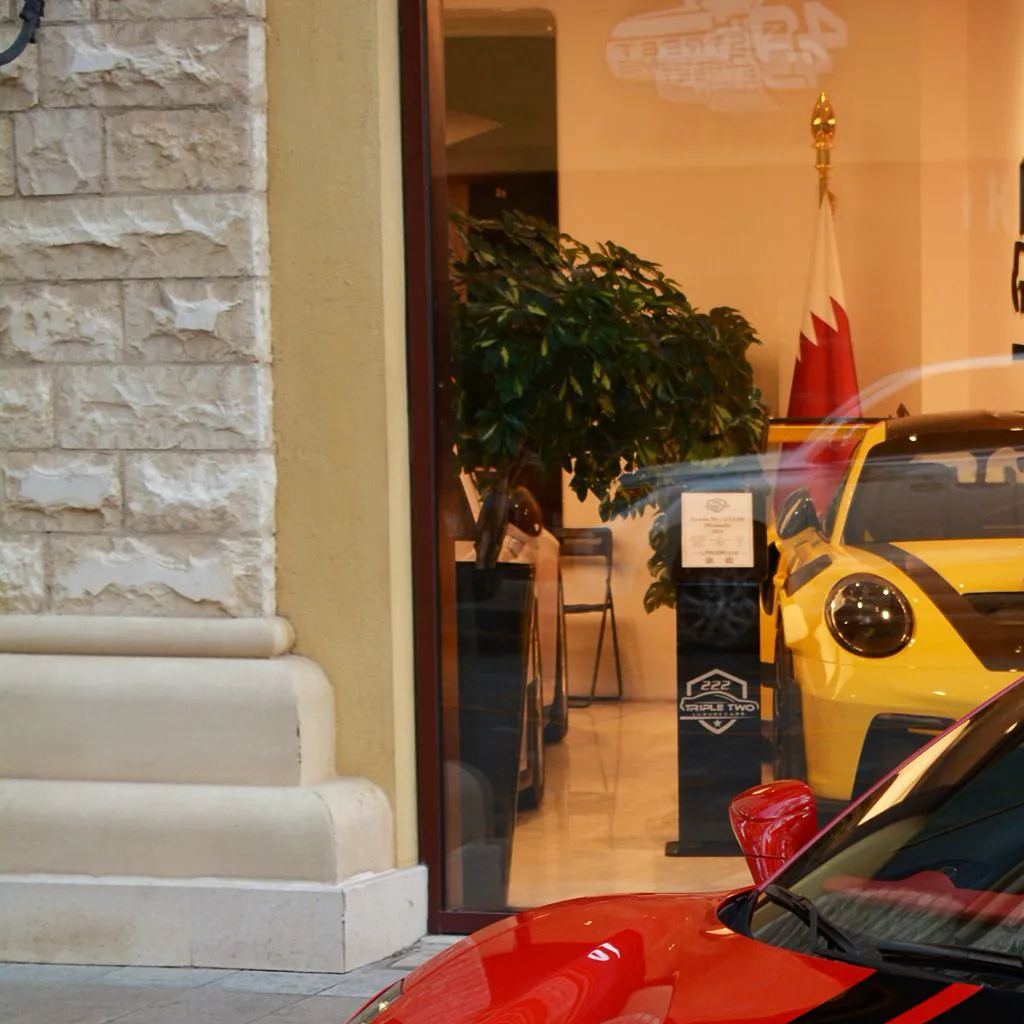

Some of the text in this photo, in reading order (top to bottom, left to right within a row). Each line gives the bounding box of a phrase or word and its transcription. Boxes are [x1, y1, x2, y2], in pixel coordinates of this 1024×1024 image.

[701, 680, 731, 691] 222
[685, 703, 755, 712] TRIPLE TWO
